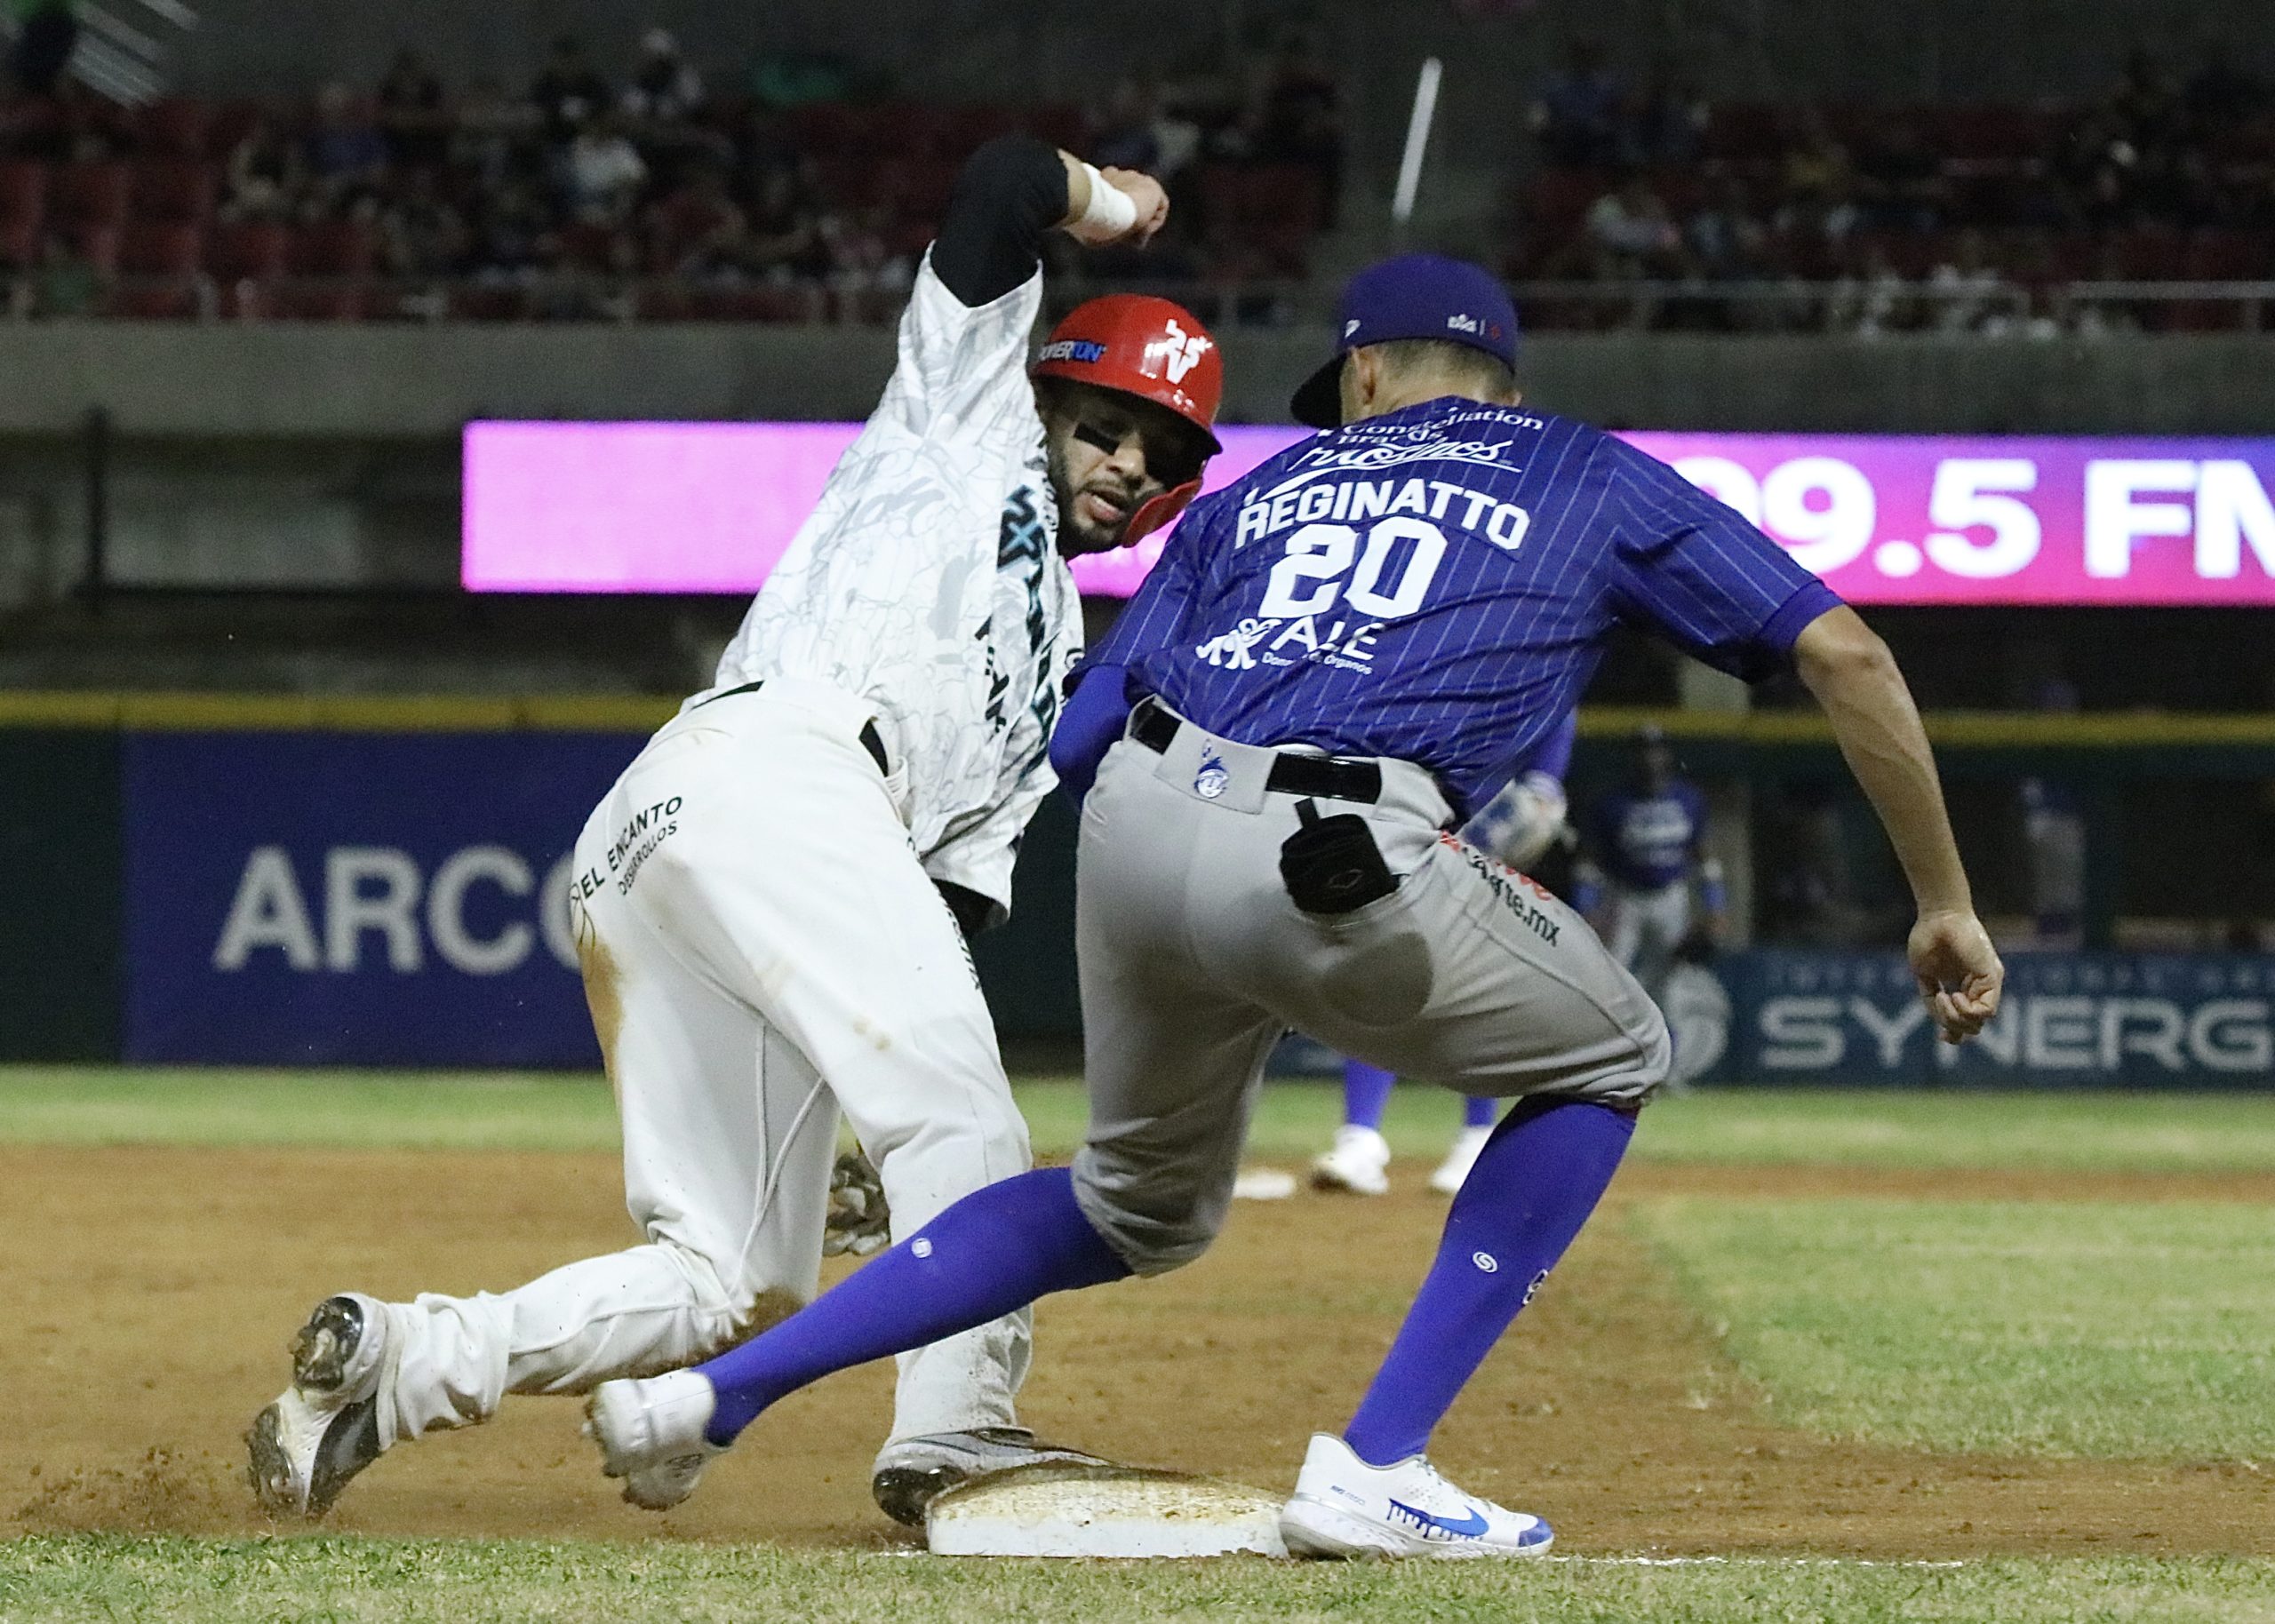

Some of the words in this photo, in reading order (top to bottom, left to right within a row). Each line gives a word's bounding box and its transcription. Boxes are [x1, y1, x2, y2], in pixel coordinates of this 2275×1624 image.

[1234, 478, 1530, 551] REGINATTO
[1257, 516, 1448, 619] 20
[580, 867, 606, 899] EL
[607, 796, 682, 872] ENCANTO
